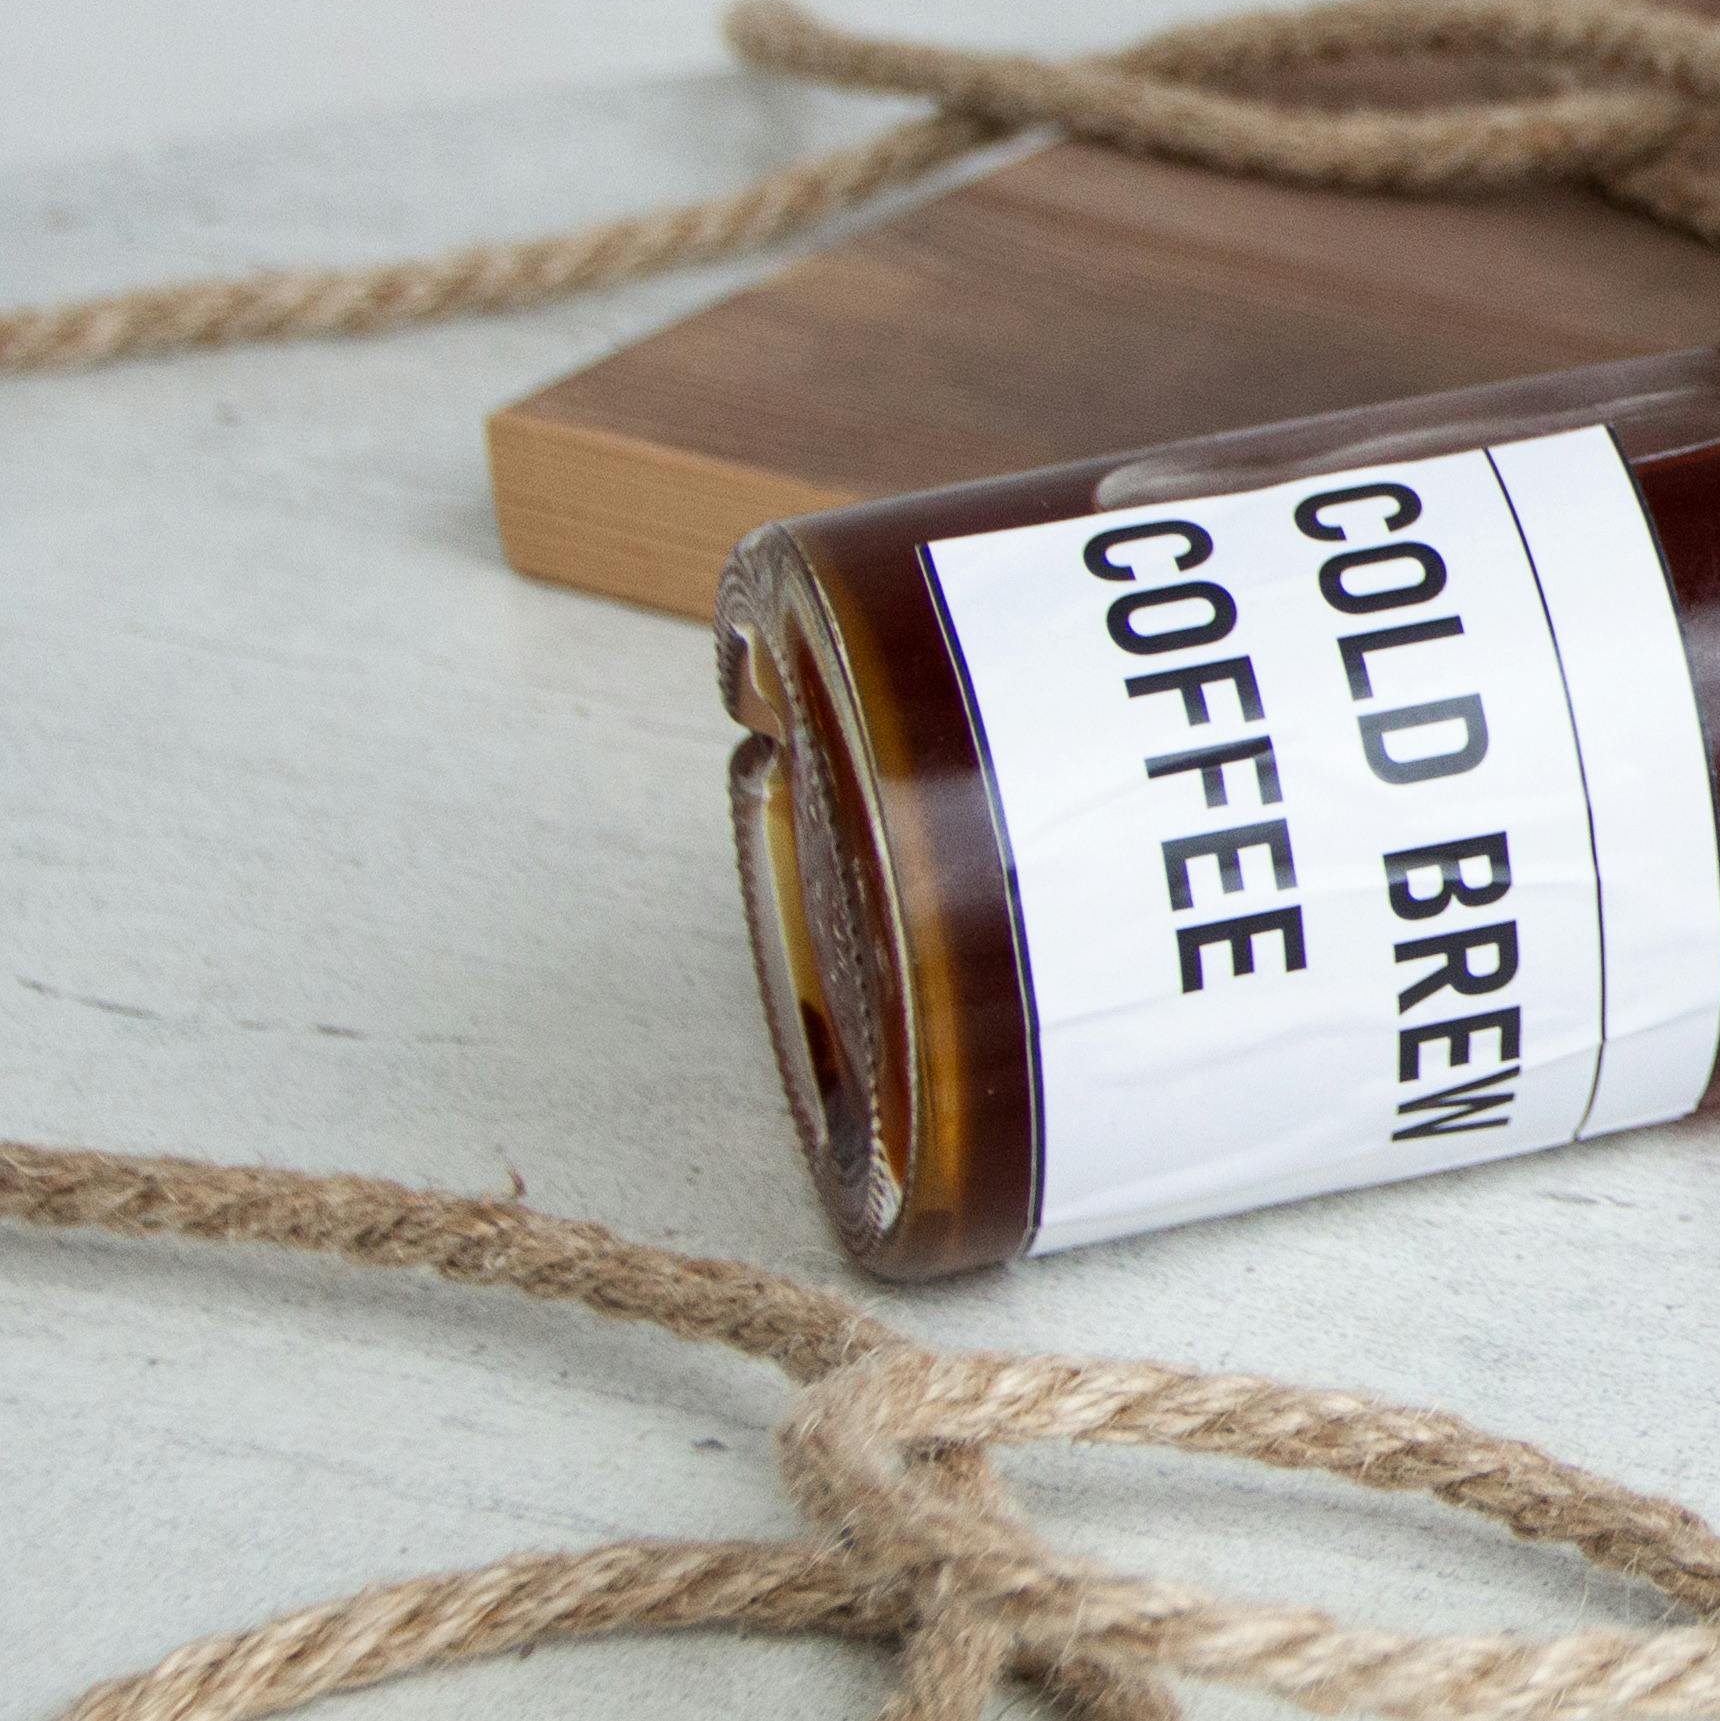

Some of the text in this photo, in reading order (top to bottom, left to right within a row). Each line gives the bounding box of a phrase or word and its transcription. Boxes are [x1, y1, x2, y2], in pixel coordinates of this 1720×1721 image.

[1082, 518, 1308, 995] COFFEE
[1293, 481, 1522, 1144] COLD BREW
